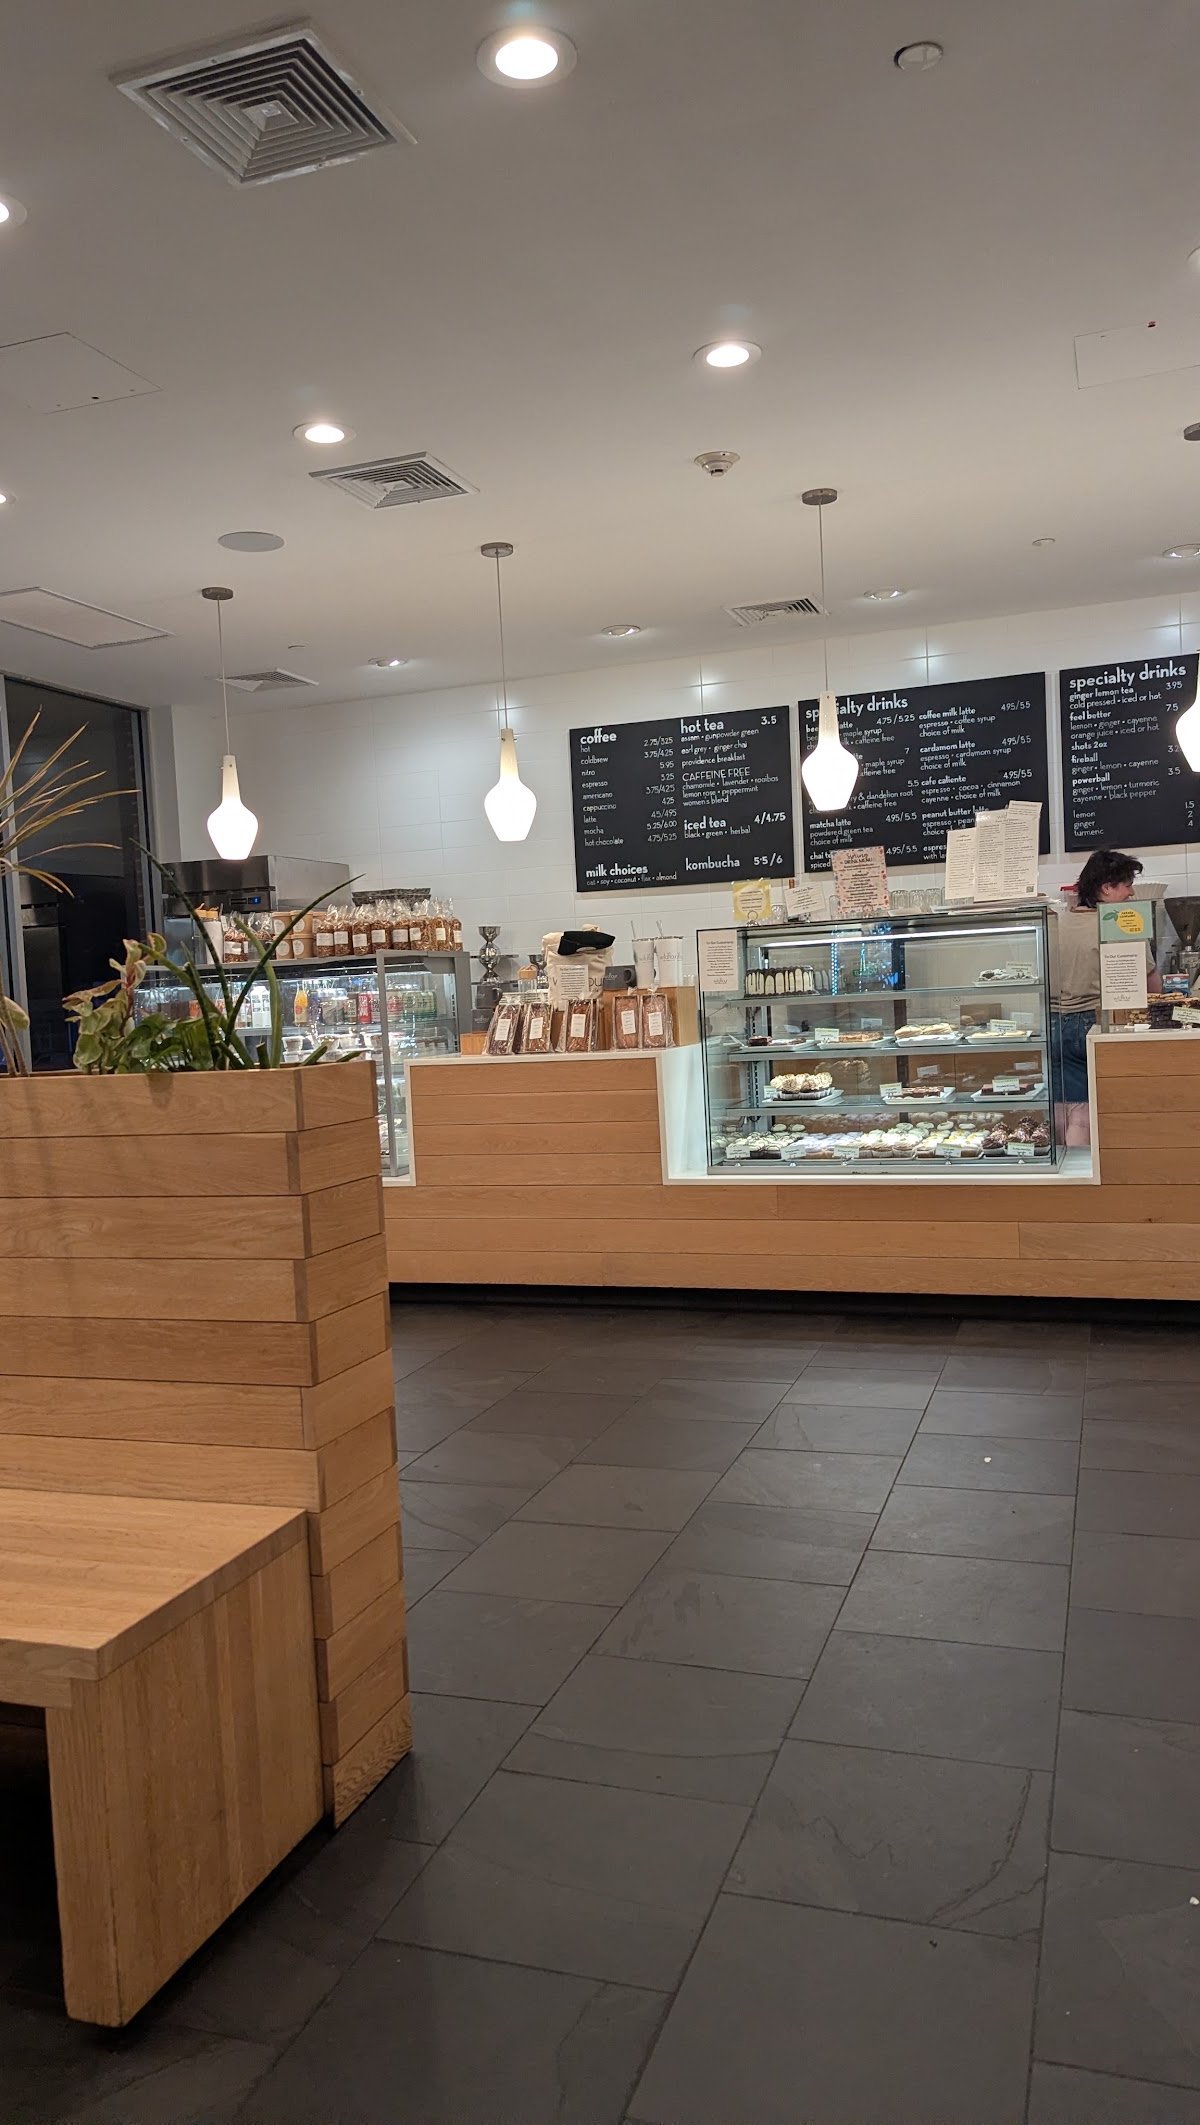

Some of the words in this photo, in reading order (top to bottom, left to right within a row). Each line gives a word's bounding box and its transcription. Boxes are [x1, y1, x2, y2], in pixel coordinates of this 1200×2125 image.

[1070, 666, 1135, 692] specialty
[1139, 660, 1186, 680] drinks
[1069, 692, 1093, 702] ginger
[1095, 689, 1119, 697] lemon
[1069, 699, 1085, 709] cold
[1087, 697, 1116, 709] pressed
[1122, 693, 1137, 703] iced
[1149, 691, 1162, 700] hot
[867, 694, 908, 711] drinks
[919, 711, 941, 720] coffee
[942, 708, 957, 717] milk
[959, 707, 976, 715] latte
[1069, 712, 1085, 721] feel
[1086, 711, 1111, 719] better
[761, 715, 776, 725] 3.5
[919, 721, 949, 730] espresso
[954, 716, 975, 724] coffee
[1070, 722, 1093, 730] lemon
[1098, 720, 1120, 729] ginger
[1127, 716, 1157, 726] cayenne
[681, 719, 701, 734] hot
[704, 718, 724, 731] tea
[942, 727, 950, 735] of
[951, 725, 965, 733] milk
[1070, 732, 1095, 740] orange
[1096, 730, 1113, 739] juice
[1120, 725, 1136, 734] iced
[1147, 723, 1160, 731] hot
[580, 728, 617, 744] coffee
[705, 729, 739, 741] gunpowder
[741, 729, 759, 737] green
[864, 728, 883, 738] syrup
[855, 736, 880, 744] caffeine
[694, 747, 707, 755] grey
[920, 744, 958, 753] cardamom
[1071, 742, 1092, 750] shots
[682, 758, 715, 769] providence
[717, 753, 745, 763] breakfast
[920, 754, 950, 764] espresso
[955, 749, 991, 758] cardamom
[993, 748, 1011, 756] syrup
[1071, 752, 1098, 763] fireball
[865, 758, 885, 770] maple
[887, 759, 905, 767] syrup
[943, 760, 950, 768] of
[952, 759, 966, 767] milk
[1072, 766, 1094, 774] ginger
[1100, 762, 1122, 770] lemon
[1128, 760, 1158, 768] cayenne
[682, 769, 726, 781] CAFFEINE
[728, 767, 750, 777] FREE
[1072, 772, 1110, 787] powerball
[582, 781, 608, 789] espresso
[682, 780, 715, 790] chamomile
[722, 777, 749, 786] lavender
[921, 777, 936, 786] cafe
[938, 775, 966, 784] caliente
[722, 785, 758, 796] peppermint
[921, 787, 950, 796] espresso
[987, 780, 1020, 788] cinnamon
[1072, 787, 1094, 796] ginger
[582, 792, 613, 800] americano
[710, 795, 729, 804] blend
[858, 792, 865, 801] &
[866, 790, 898, 799] dandelion
[921, 796, 949, 804] cayenne
[955, 792, 977, 800] choice
[979, 790, 986, 798] of
[987, 788, 1001, 797] milk
[1072, 795, 1102, 804] cayenne
[1108, 790, 1128, 800] black
[1129, 790, 1156, 799] pepper
[583, 804, 616, 812] cappuccino
[857, 800, 882, 809] caffeine
[884, 799, 897, 807] free
[754, 812, 786, 824] 4/4.75
[922, 810, 947, 821] peanut
[948, 808, 971, 816] butter
[1073, 810, 1095, 818] lemon
[1188, 810, 1193, 818] 2
[684, 817, 706, 831] iced
[709, 817, 726, 828] tea
[810, 819, 835, 829] matcha
[835, 818, 851, 826] latte
[922, 820, 952, 830] espresso
[1074, 821, 1095, 830] ginger
[584, 826, 604, 835] mocha
[684, 830, 701, 838] black
[705, 831, 723, 839] green
[810, 827, 843, 839] powdered
[843, 828, 861, 837] green
[923, 828, 944, 836] choice
[595, 838, 623, 846] chocolate
[810, 837, 831, 846] choice
[832, 836, 839, 844] of
[840, 834, 853, 843] milk
[810, 852, 823, 860] chai
[923, 852, 937, 860] with
[685, 854, 740, 870] kombucha
[810, 860, 831, 870] spiced
[586, 864, 607, 877] milk
[609, 863, 648, 876] choices
[614, 876, 636, 884] coconut
[656, 872, 677, 880] almond
